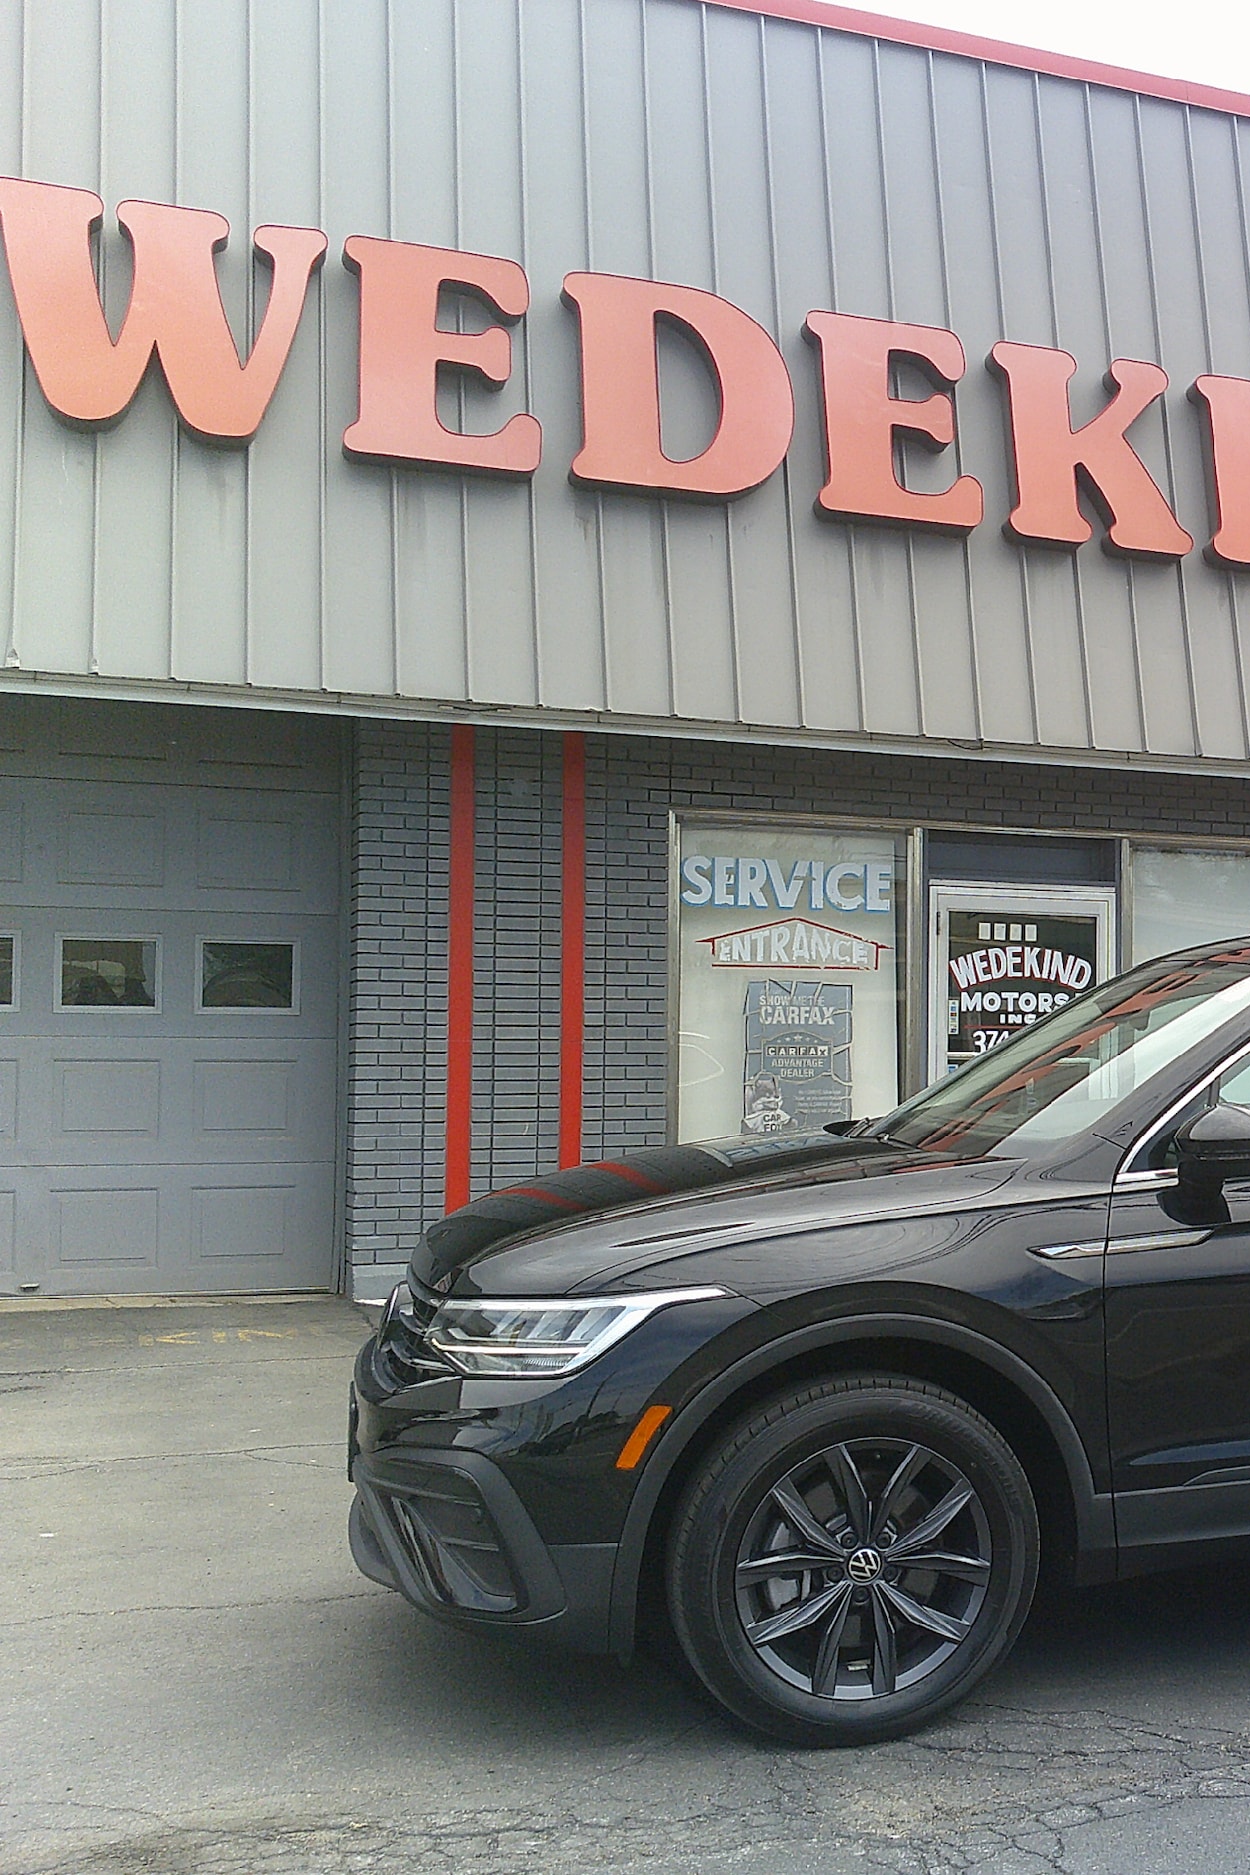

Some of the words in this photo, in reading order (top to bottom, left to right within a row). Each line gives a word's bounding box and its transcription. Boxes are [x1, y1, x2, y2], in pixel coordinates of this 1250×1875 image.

[682, 855, 893, 912] SERVICE
[718, 922, 869, 965] ENTRANCE
[949, 946, 1092, 991] WEDEKIND
[961, 991, 1070, 1012] MOTORS
[760, 1006, 835, 1025] CARFAX
[766, 1045, 829, 1056] CARFAX
[771, 1058, 824, 1068] ADVANTAGE
[780, 1067, 815, 1078] DEALER
